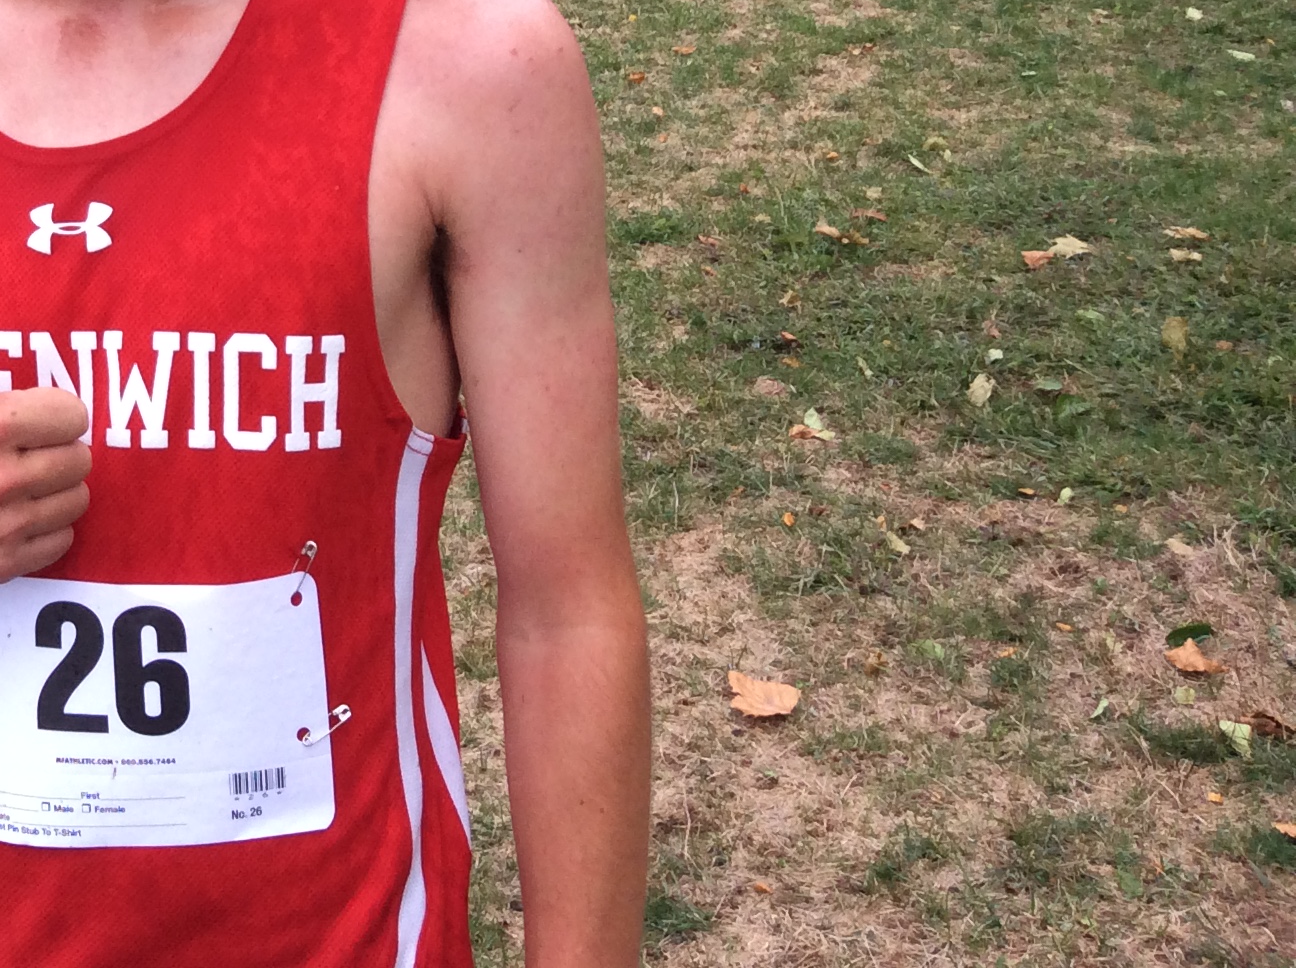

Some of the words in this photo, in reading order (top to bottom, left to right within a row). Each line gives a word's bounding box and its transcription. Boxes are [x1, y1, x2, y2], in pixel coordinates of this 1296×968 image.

[35, 600, 191, 736] 26
[53, 805, 74, 813] Male
[250, 806, 262, 817] 26
[8, 824, 19, 832] Pin
[21, 826, 39, 836] Stub
[54, 829, 81, 837] T-Shirt
